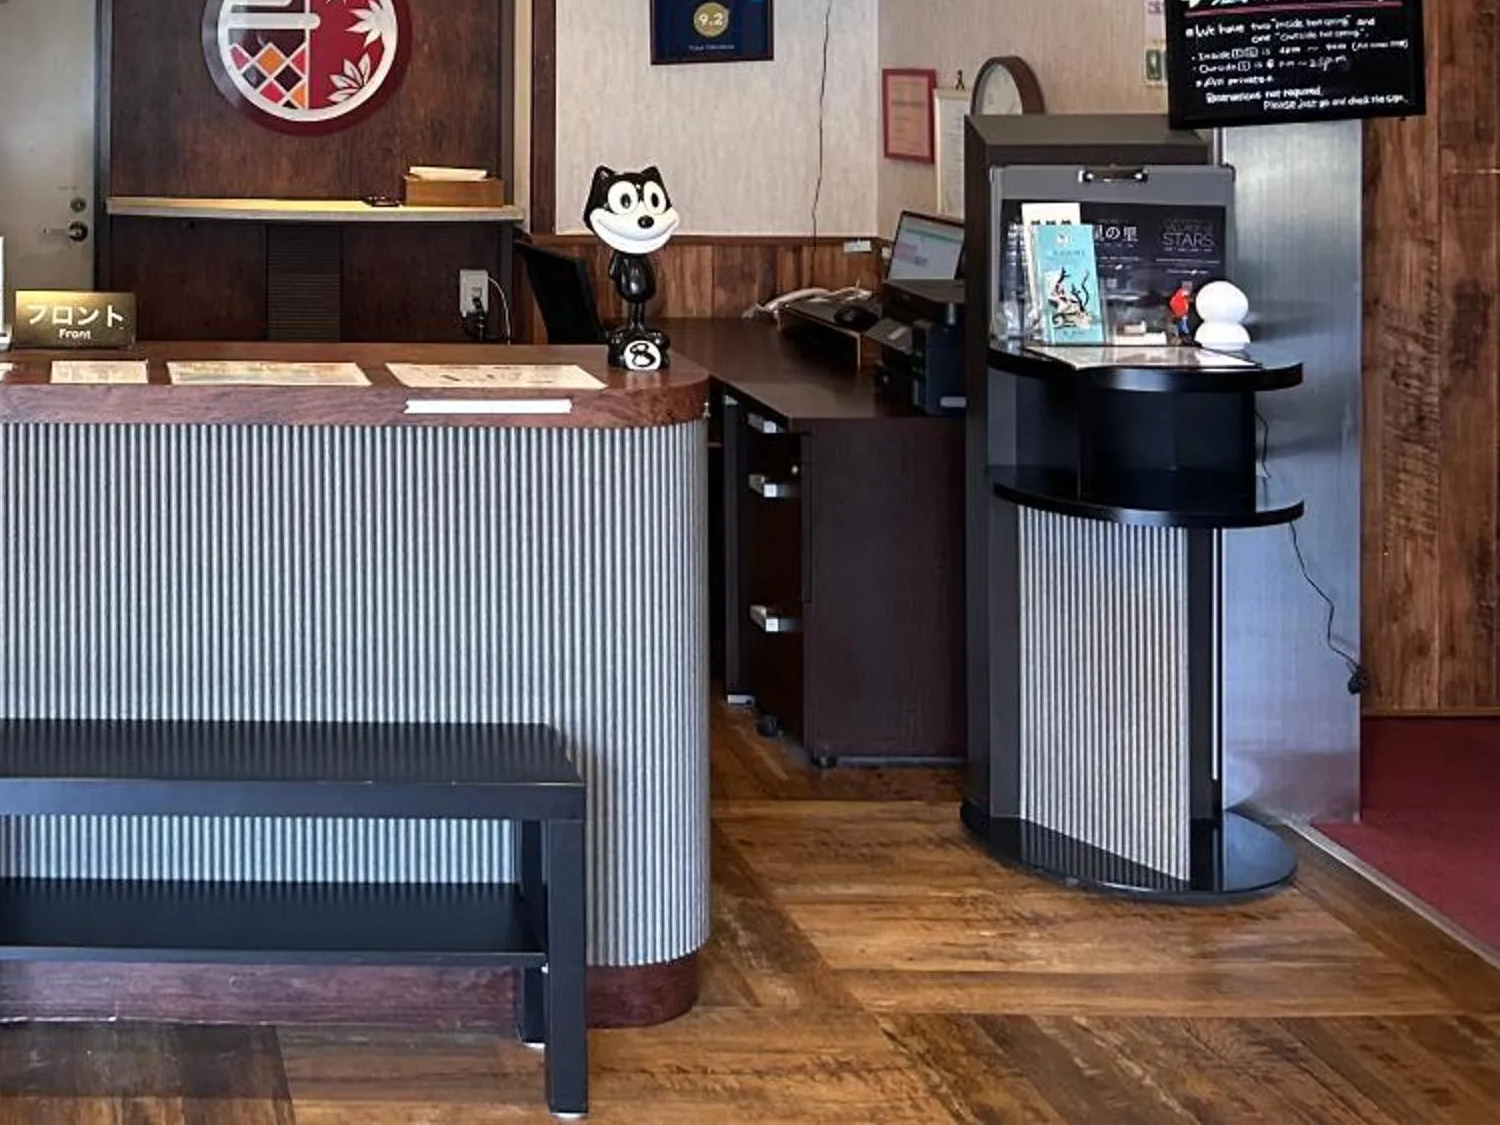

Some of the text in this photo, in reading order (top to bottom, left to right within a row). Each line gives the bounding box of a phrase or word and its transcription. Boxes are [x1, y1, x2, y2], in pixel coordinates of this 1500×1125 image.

[699, 12, 725, 26] 9.2
[1162, 232, 1216, 248] STARS
[27, 304, 124, 328] フロント
[59, 328, 91, 339] Front
